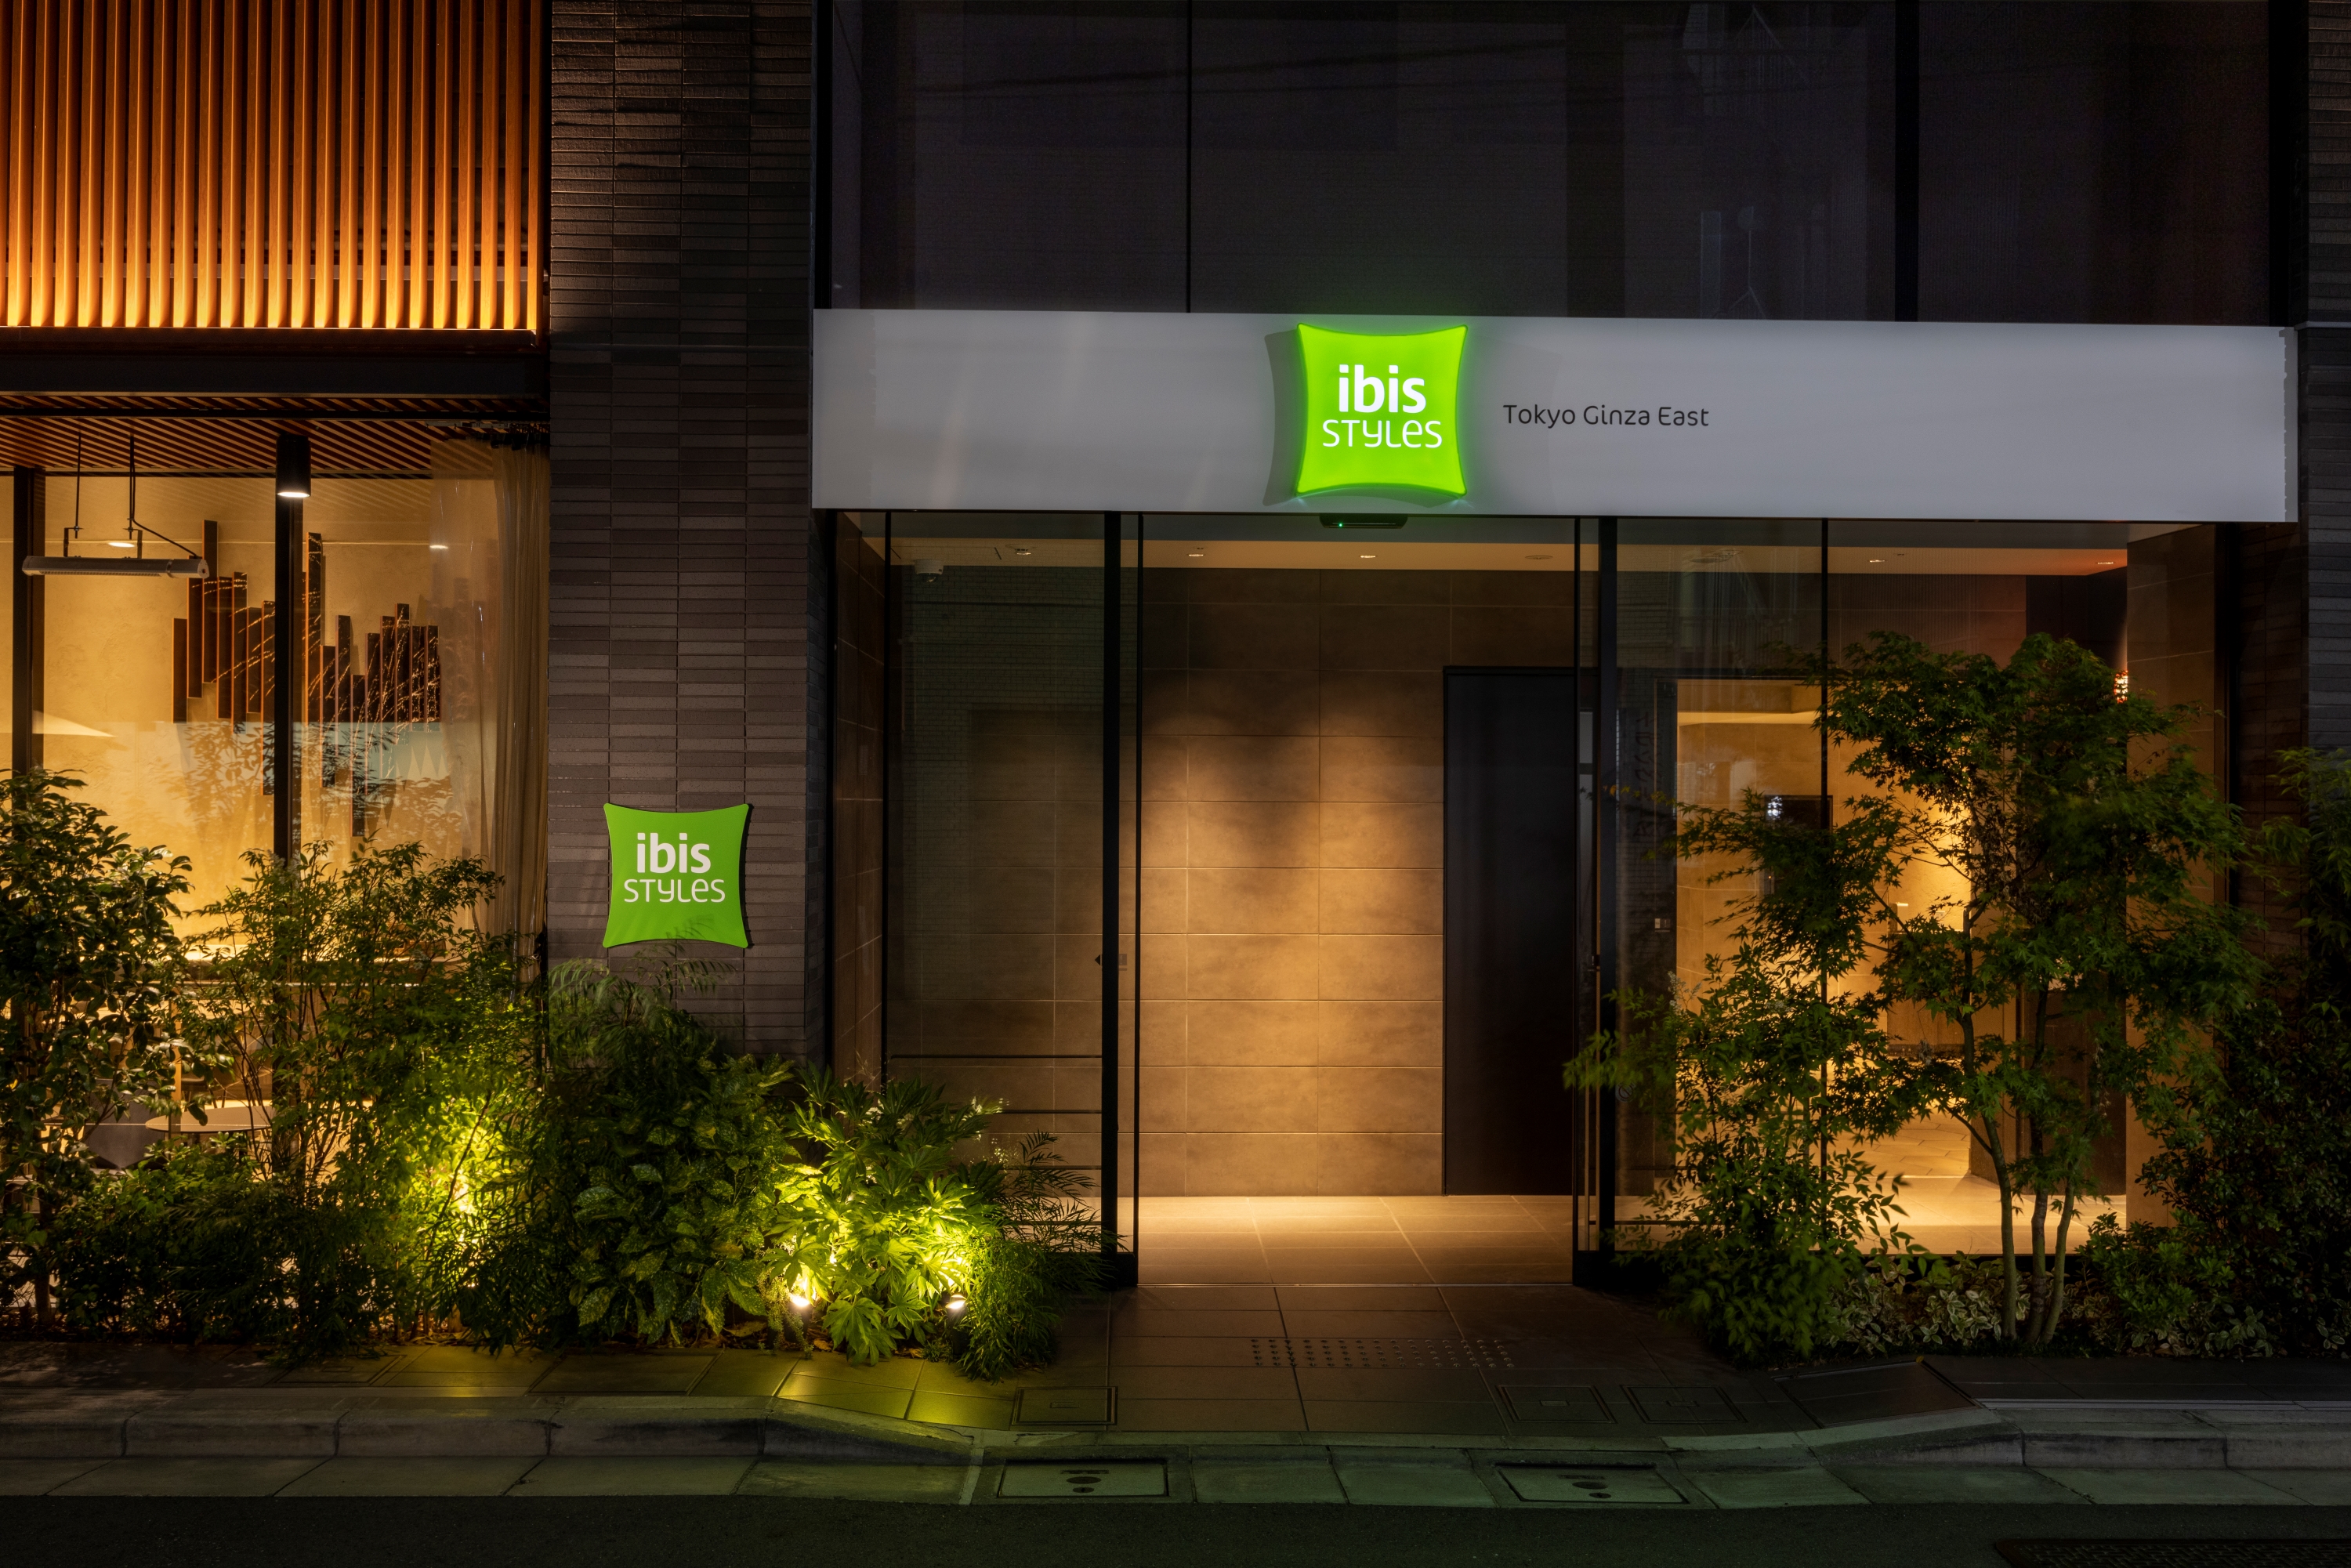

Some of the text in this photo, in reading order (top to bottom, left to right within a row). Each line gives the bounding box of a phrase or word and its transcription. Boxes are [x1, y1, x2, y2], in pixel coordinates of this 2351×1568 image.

[1339, 364, 1426, 413] ibis
[1502, 404, 1709, 429] Tokyo Ginza East
[637, 832, 712, 874] ibis
